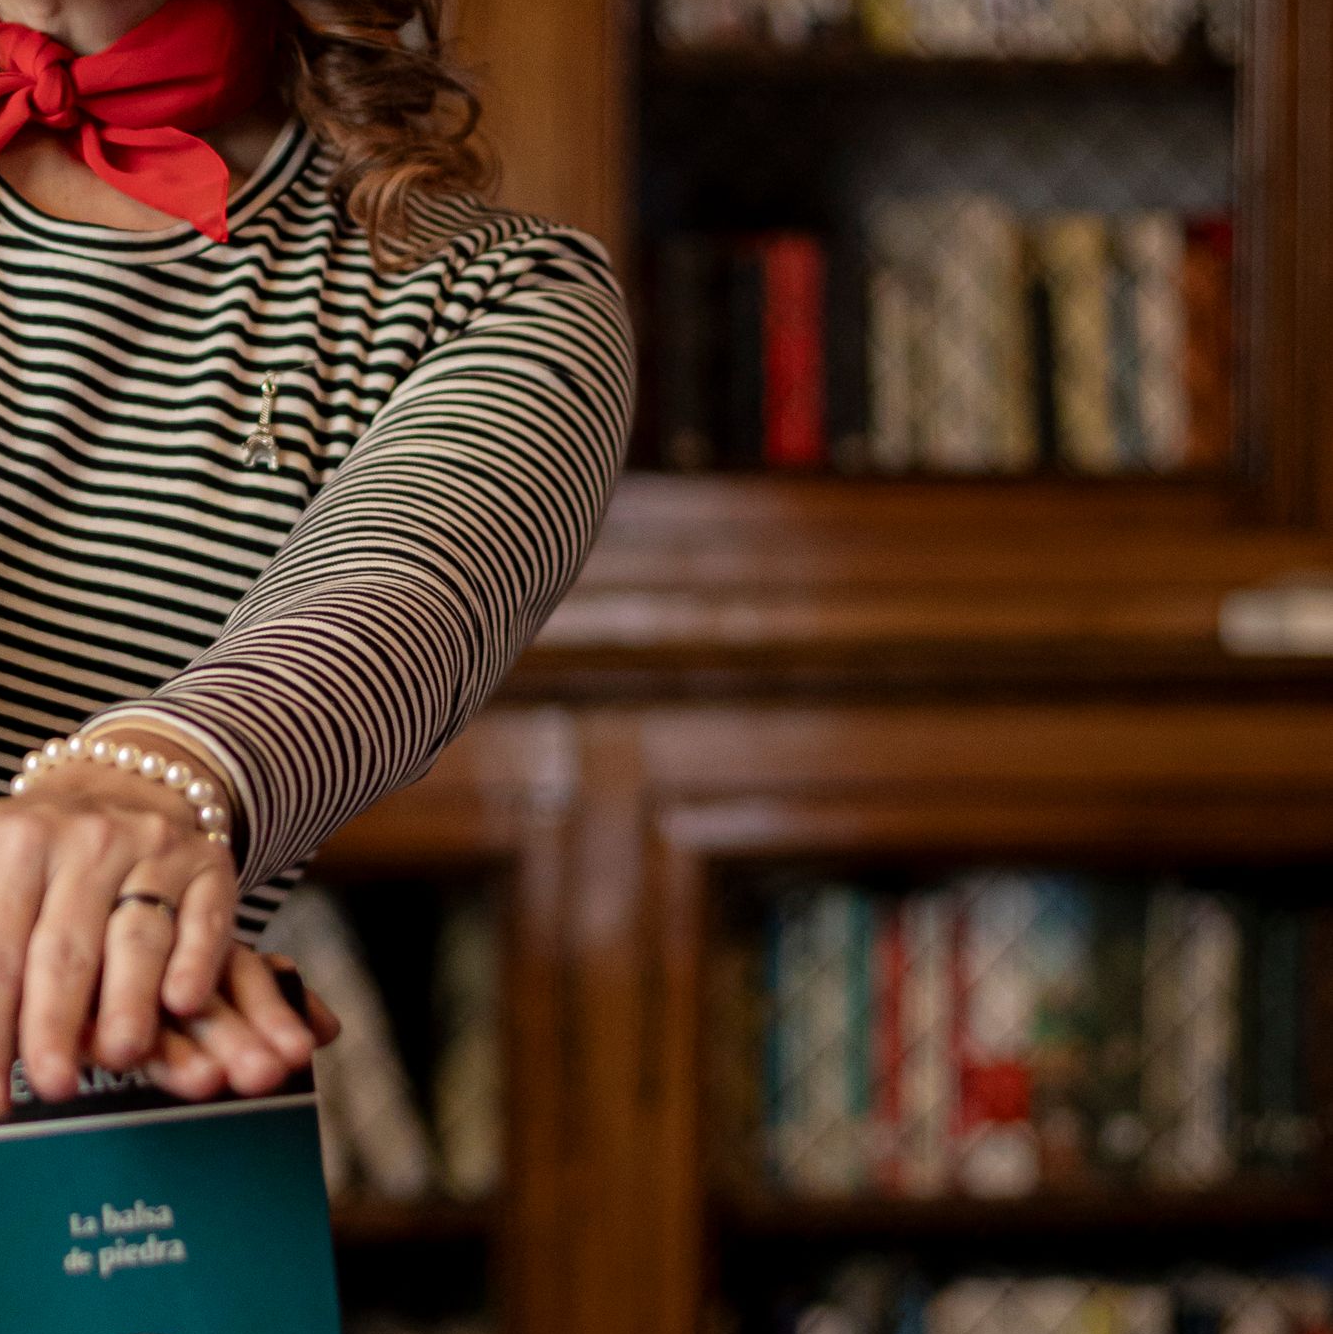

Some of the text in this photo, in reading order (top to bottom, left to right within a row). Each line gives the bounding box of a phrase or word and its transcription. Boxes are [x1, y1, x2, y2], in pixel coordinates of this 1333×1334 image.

[70, 1199, 174, 1237] La balsa
[64, 1233, 186, 1279] de piedra
